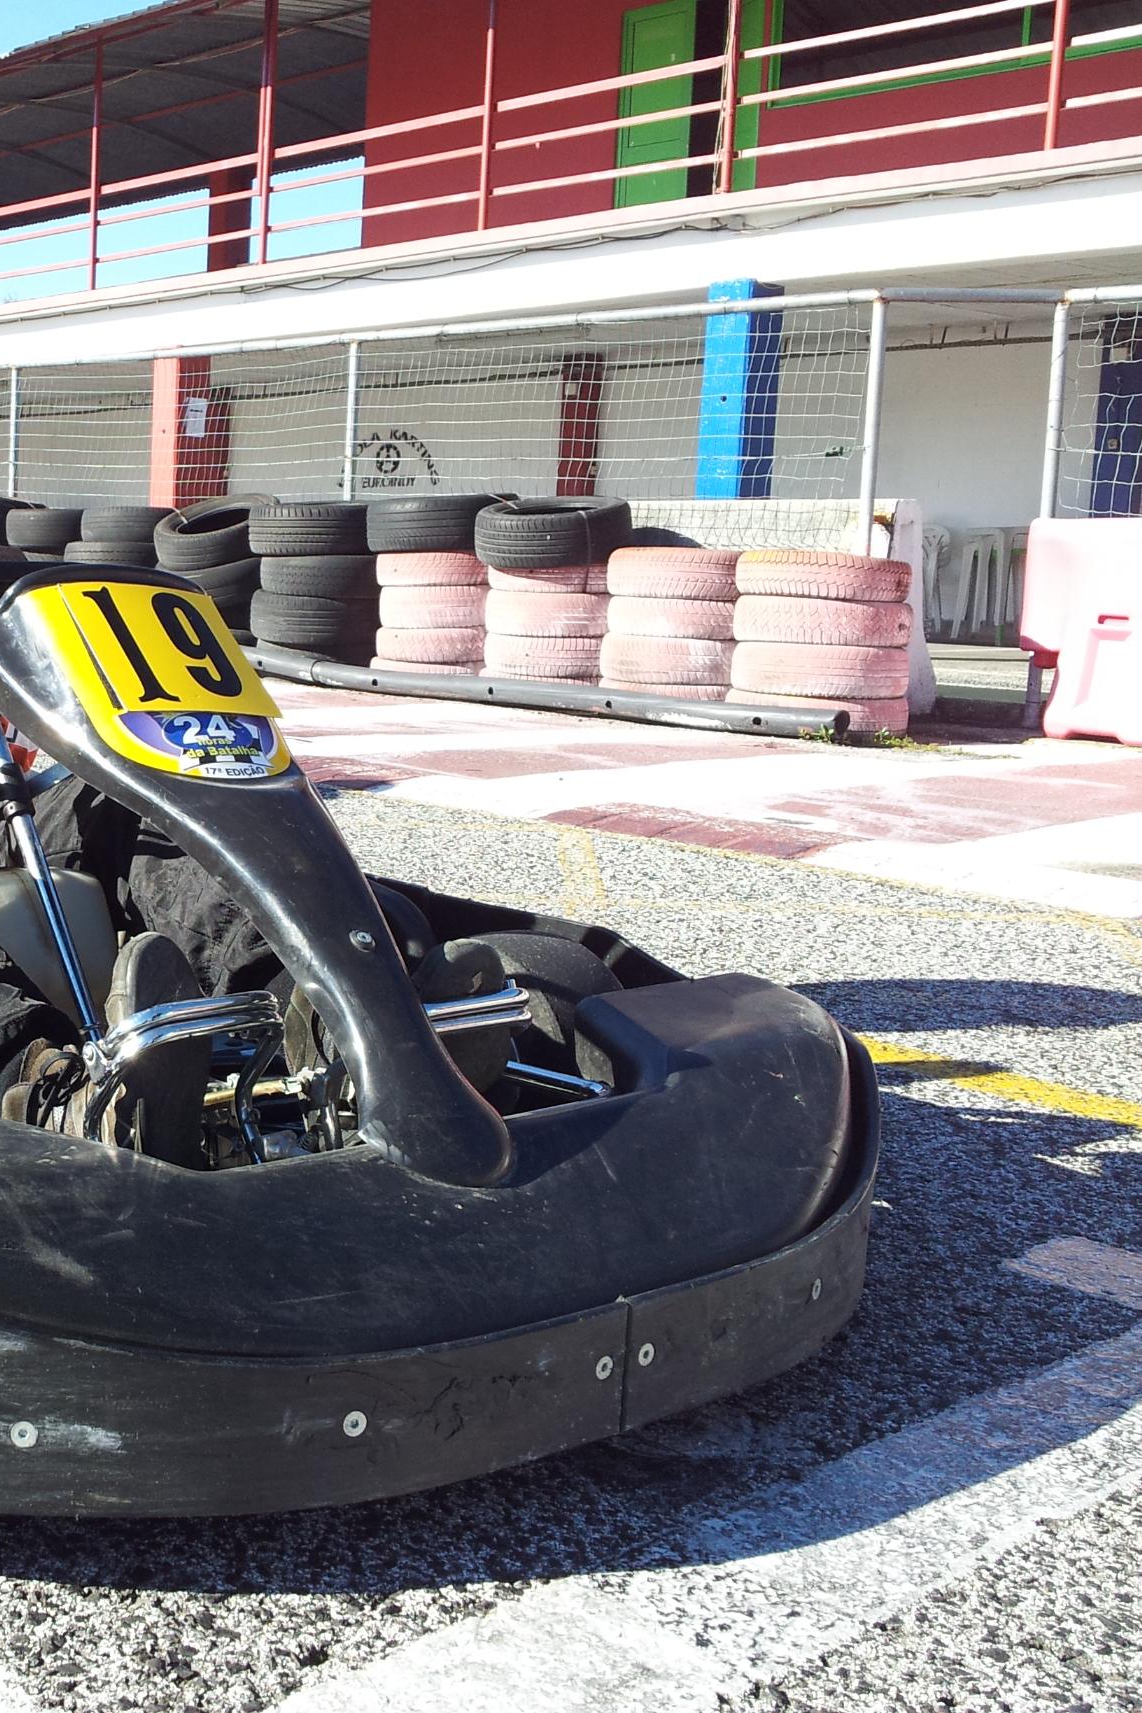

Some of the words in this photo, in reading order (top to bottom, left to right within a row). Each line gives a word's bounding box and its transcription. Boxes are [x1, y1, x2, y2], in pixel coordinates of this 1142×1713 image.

[81, 586, 243, 702] 19
[173, 714, 237, 745] 24
[186, 748, 205, 759] da
[208, 746, 259, 757] Batalha
[226, 765, 266, 777] EDIÇÃO
